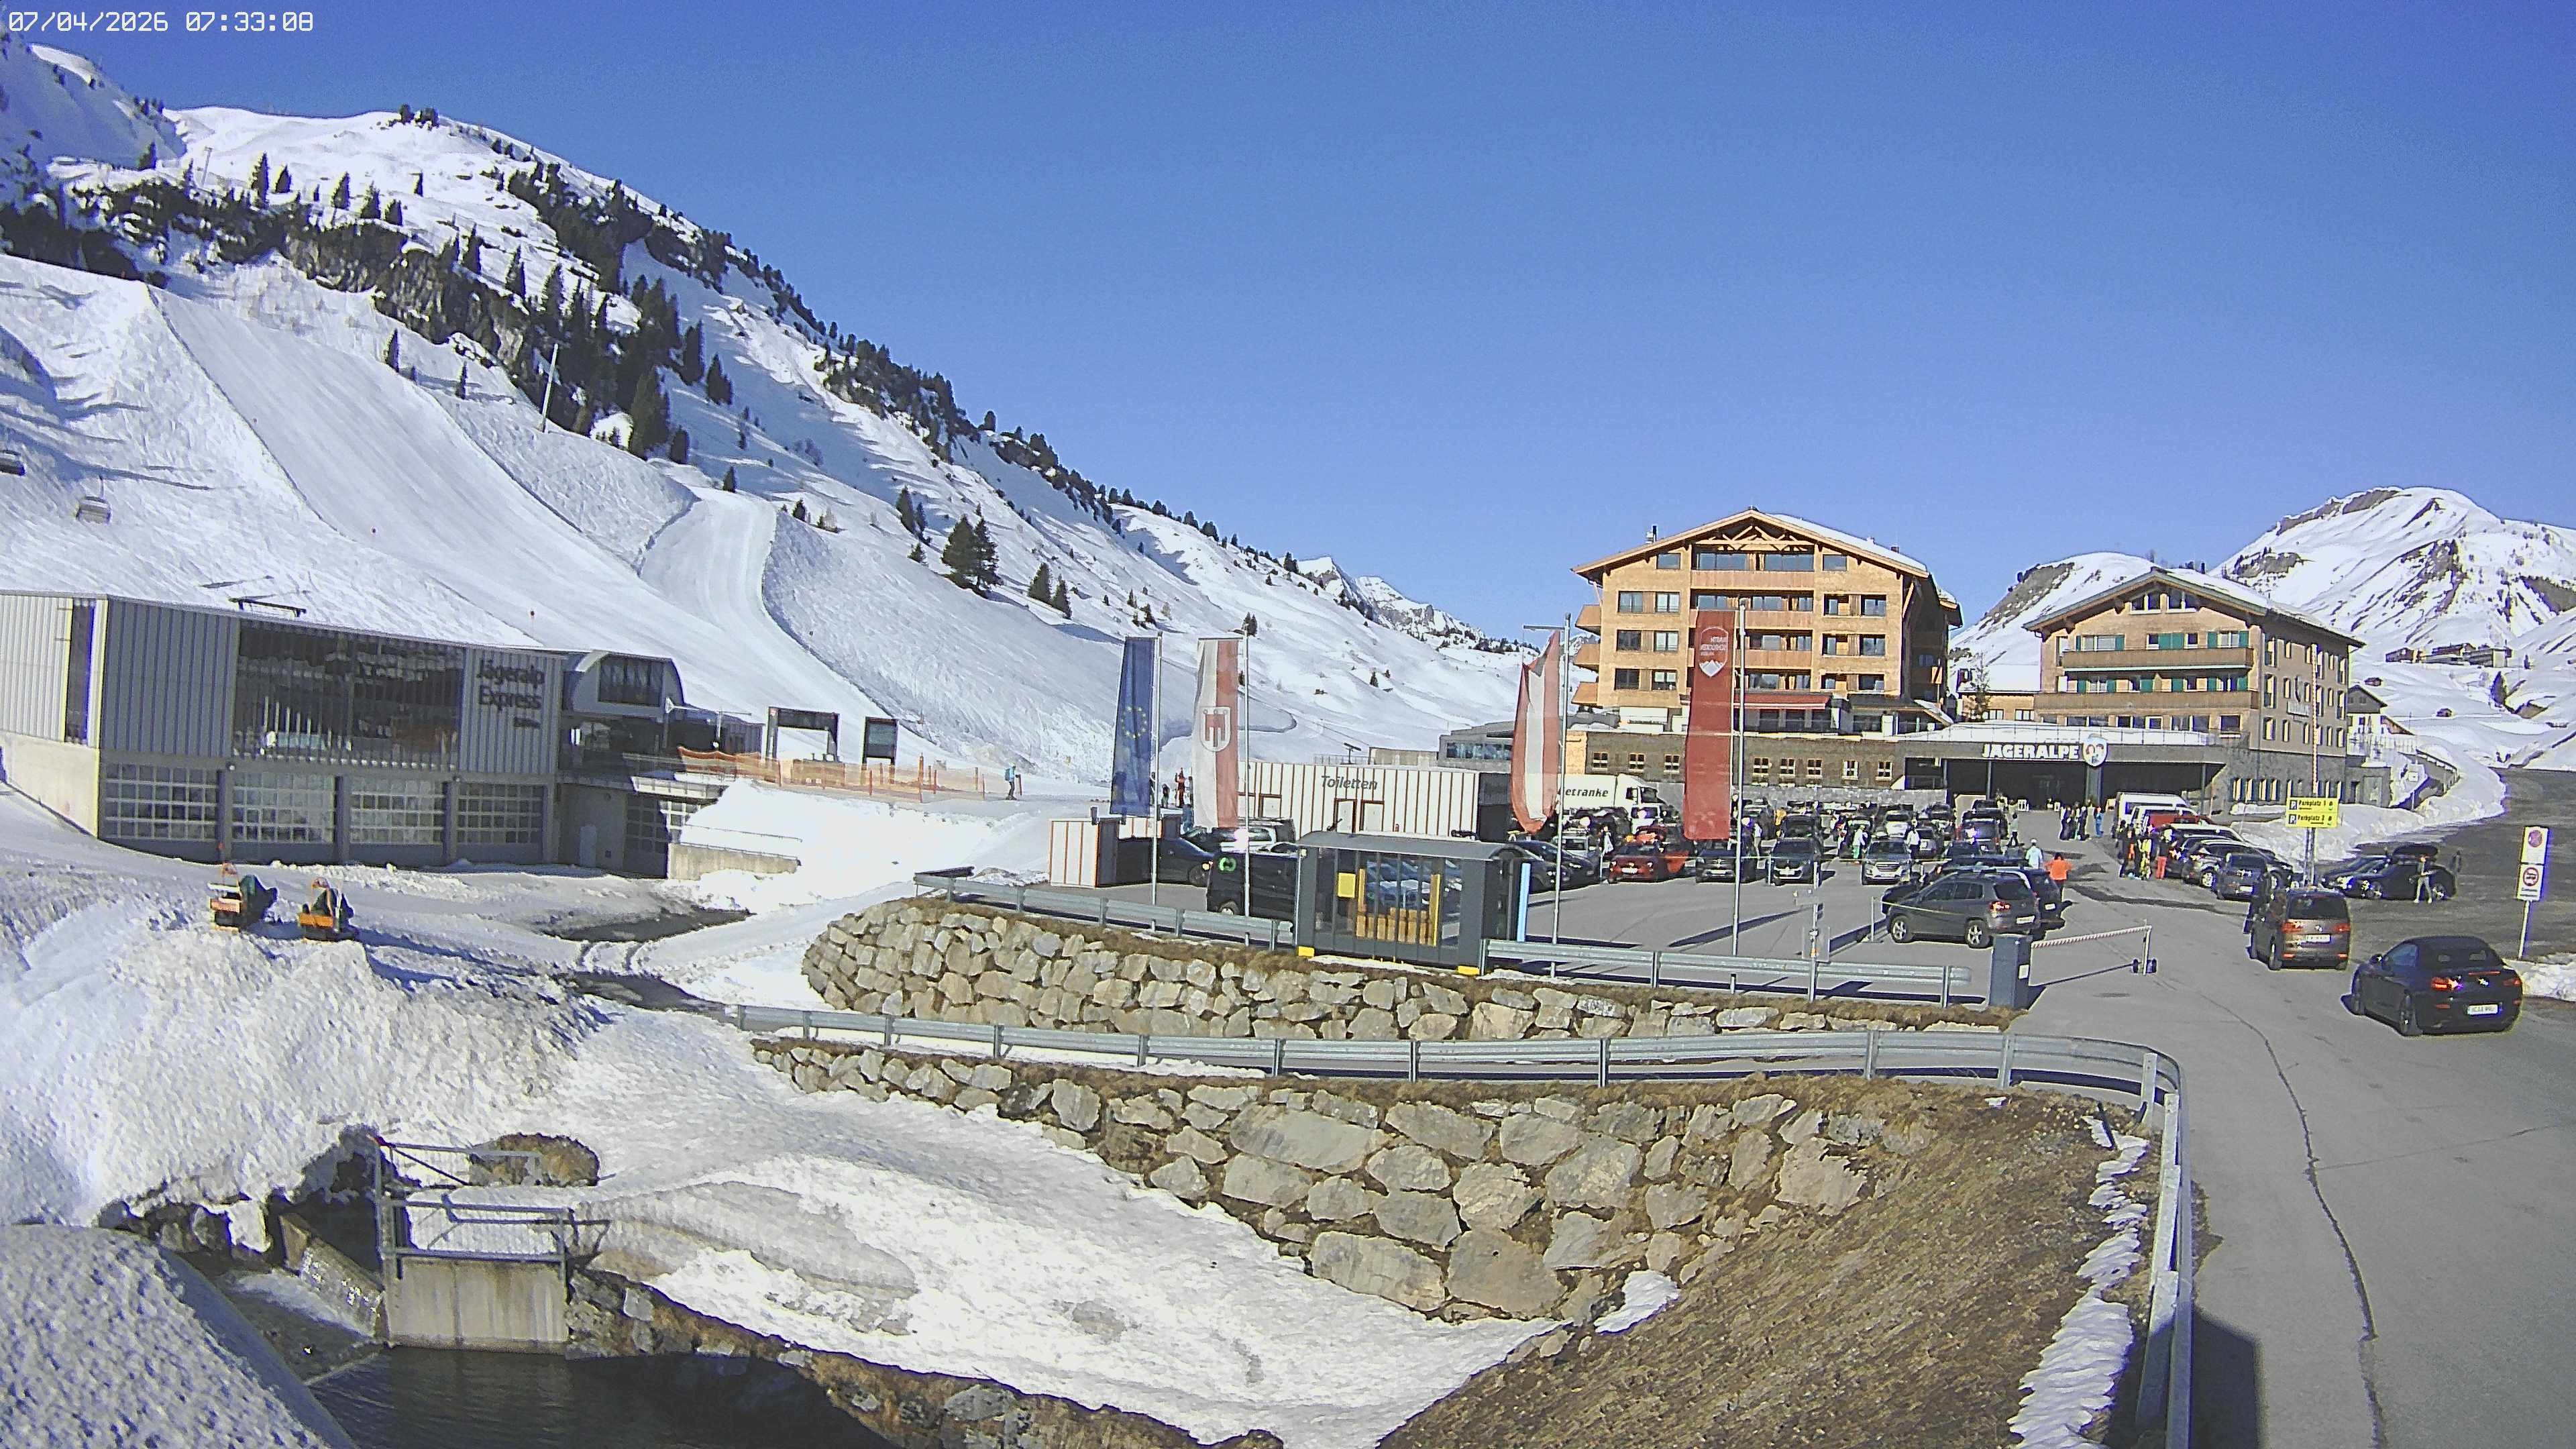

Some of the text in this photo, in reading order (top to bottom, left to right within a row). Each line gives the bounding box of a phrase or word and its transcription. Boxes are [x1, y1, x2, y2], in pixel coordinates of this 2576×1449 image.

[477, 659, 545, 688] Jägeralp
[478, 685, 542, 710] Express
[1321, 775, 1378, 790] Toiletten
